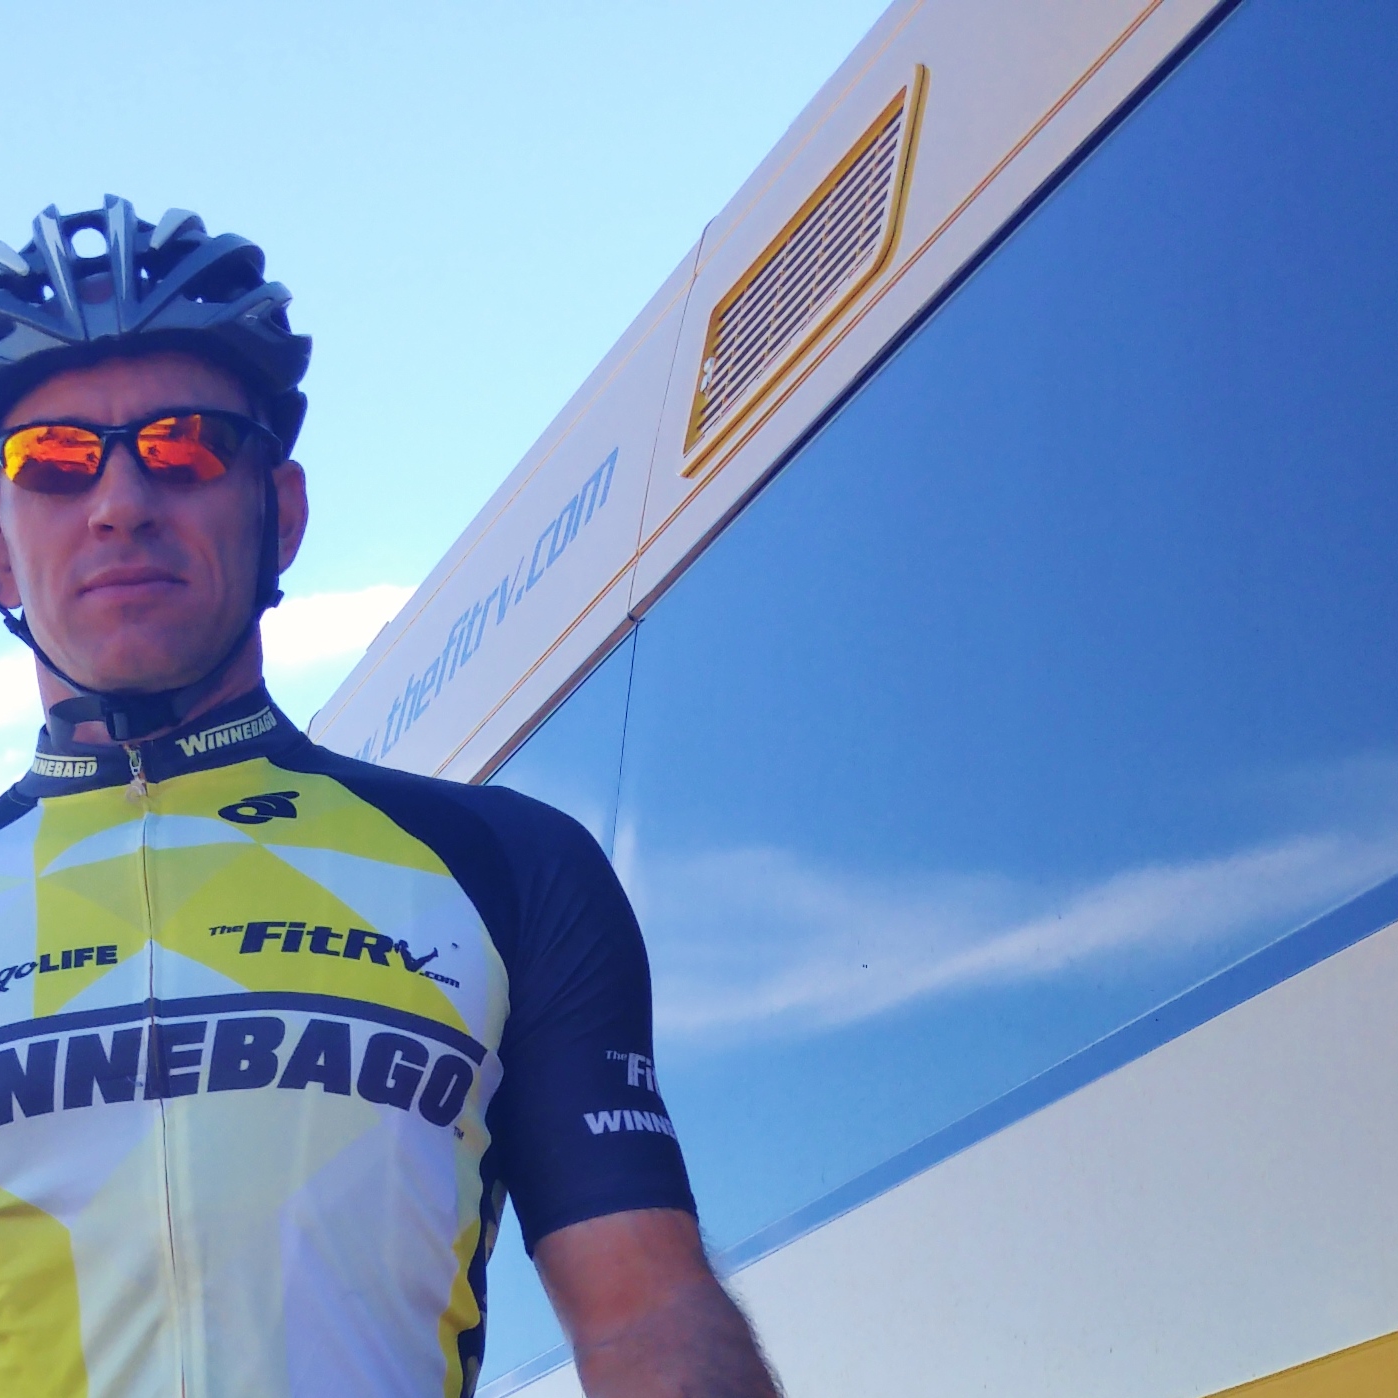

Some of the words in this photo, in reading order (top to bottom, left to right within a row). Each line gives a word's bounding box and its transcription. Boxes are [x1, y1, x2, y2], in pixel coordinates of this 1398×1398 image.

[355, 446, 619, 764] .thefitrv.com
[175, 706, 277, 757] WINNEBAGO
[31, 752, 98, 778] NNEBAGO
